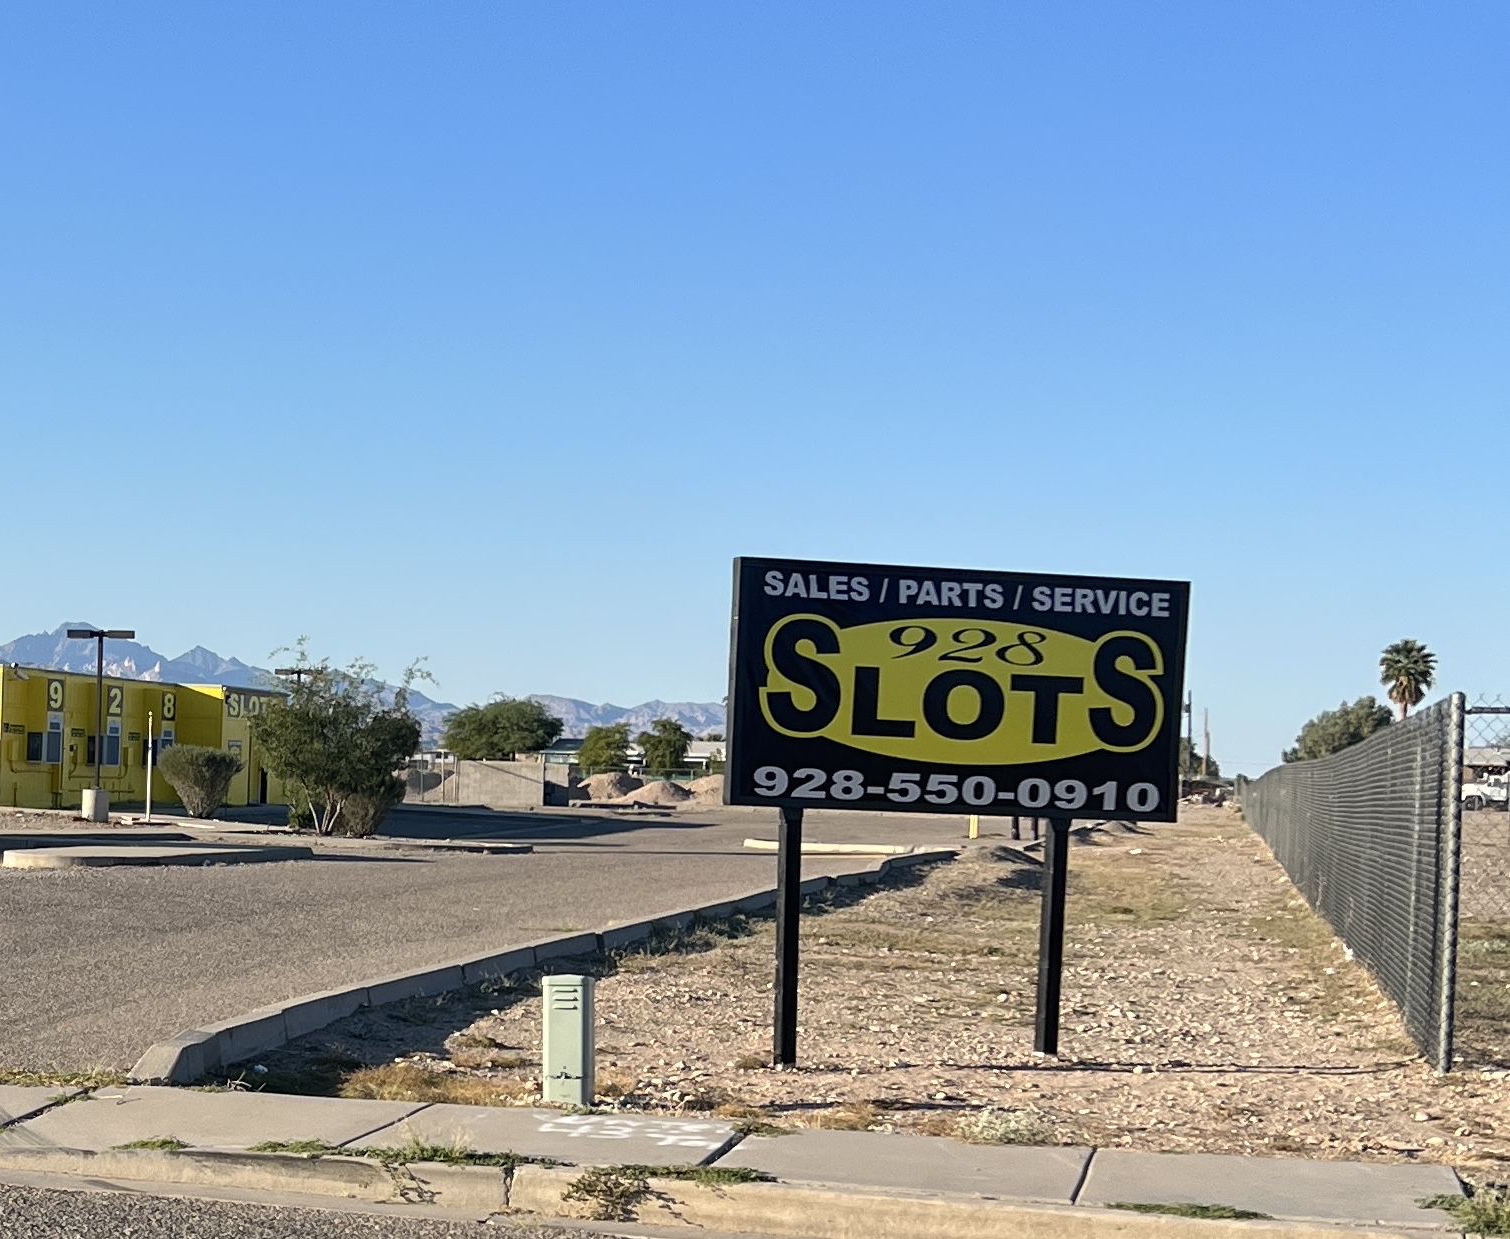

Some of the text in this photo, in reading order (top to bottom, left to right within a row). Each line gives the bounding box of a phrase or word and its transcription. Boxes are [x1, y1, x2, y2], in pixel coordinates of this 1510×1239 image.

[764, 570, 870, 602] SALES
[899, 580, 1005, 609] PARTS
[1032, 586, 1171, 617] SERVICE
[890, 626, 1047, 667] 928
[50, 681, 175, 719] 9 2 8
[763, 617, 1160, 749] SLOTS
[229, 693, 276, 718] SLOT
[753, 765, 1160, 812] 928-550-0910
